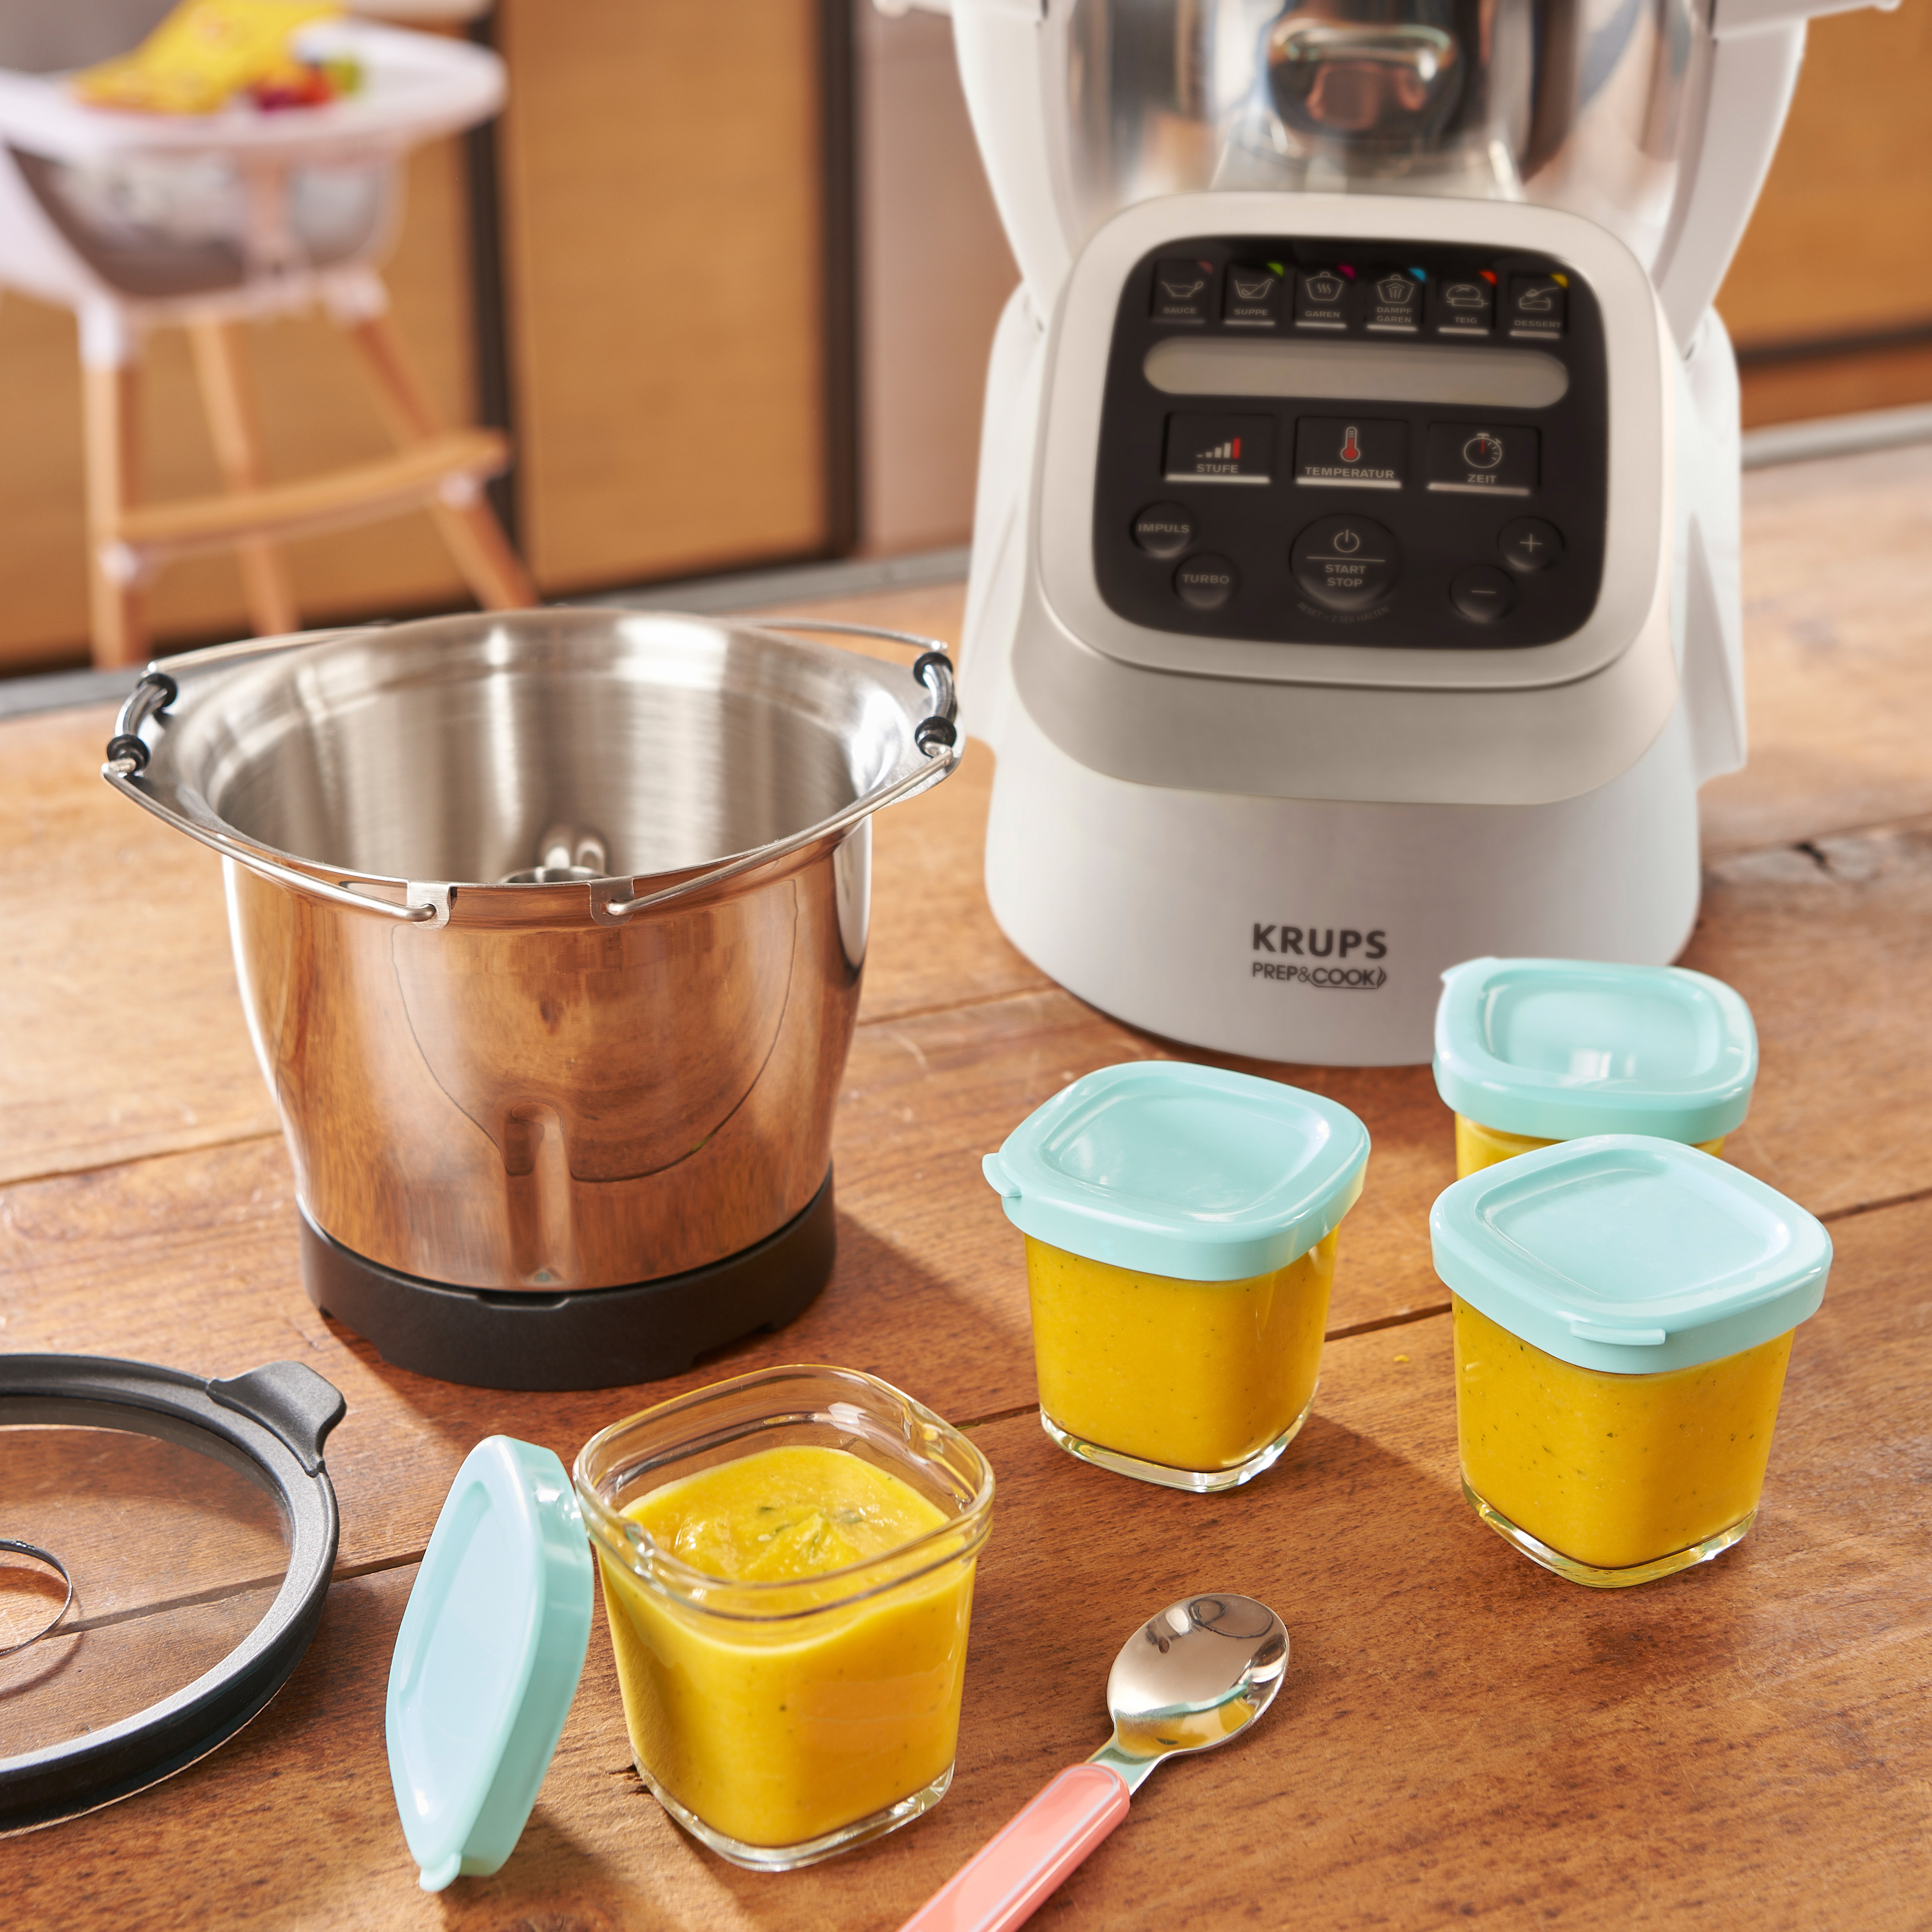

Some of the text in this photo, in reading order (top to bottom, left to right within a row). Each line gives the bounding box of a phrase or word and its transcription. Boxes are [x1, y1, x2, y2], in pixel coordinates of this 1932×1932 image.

[1514, 320, 1562, 328] DESSERT
[1196, 464, 1239, 474] STUFE
[1304, 466, 1395, 479] TEMPERATUR
[1467, 474, 1497, 484] ZEIT
[1138, 523, 1190, 534] IMPULS
[1325, 564, 1367, 575] START
[1182, 574, 1230, 585] TURBO
[1326, 577, 1363, 587] STOP
[1357, 606, 1390, 622] HALTEN
[1252, 923, 1387, 959] KRUPS
